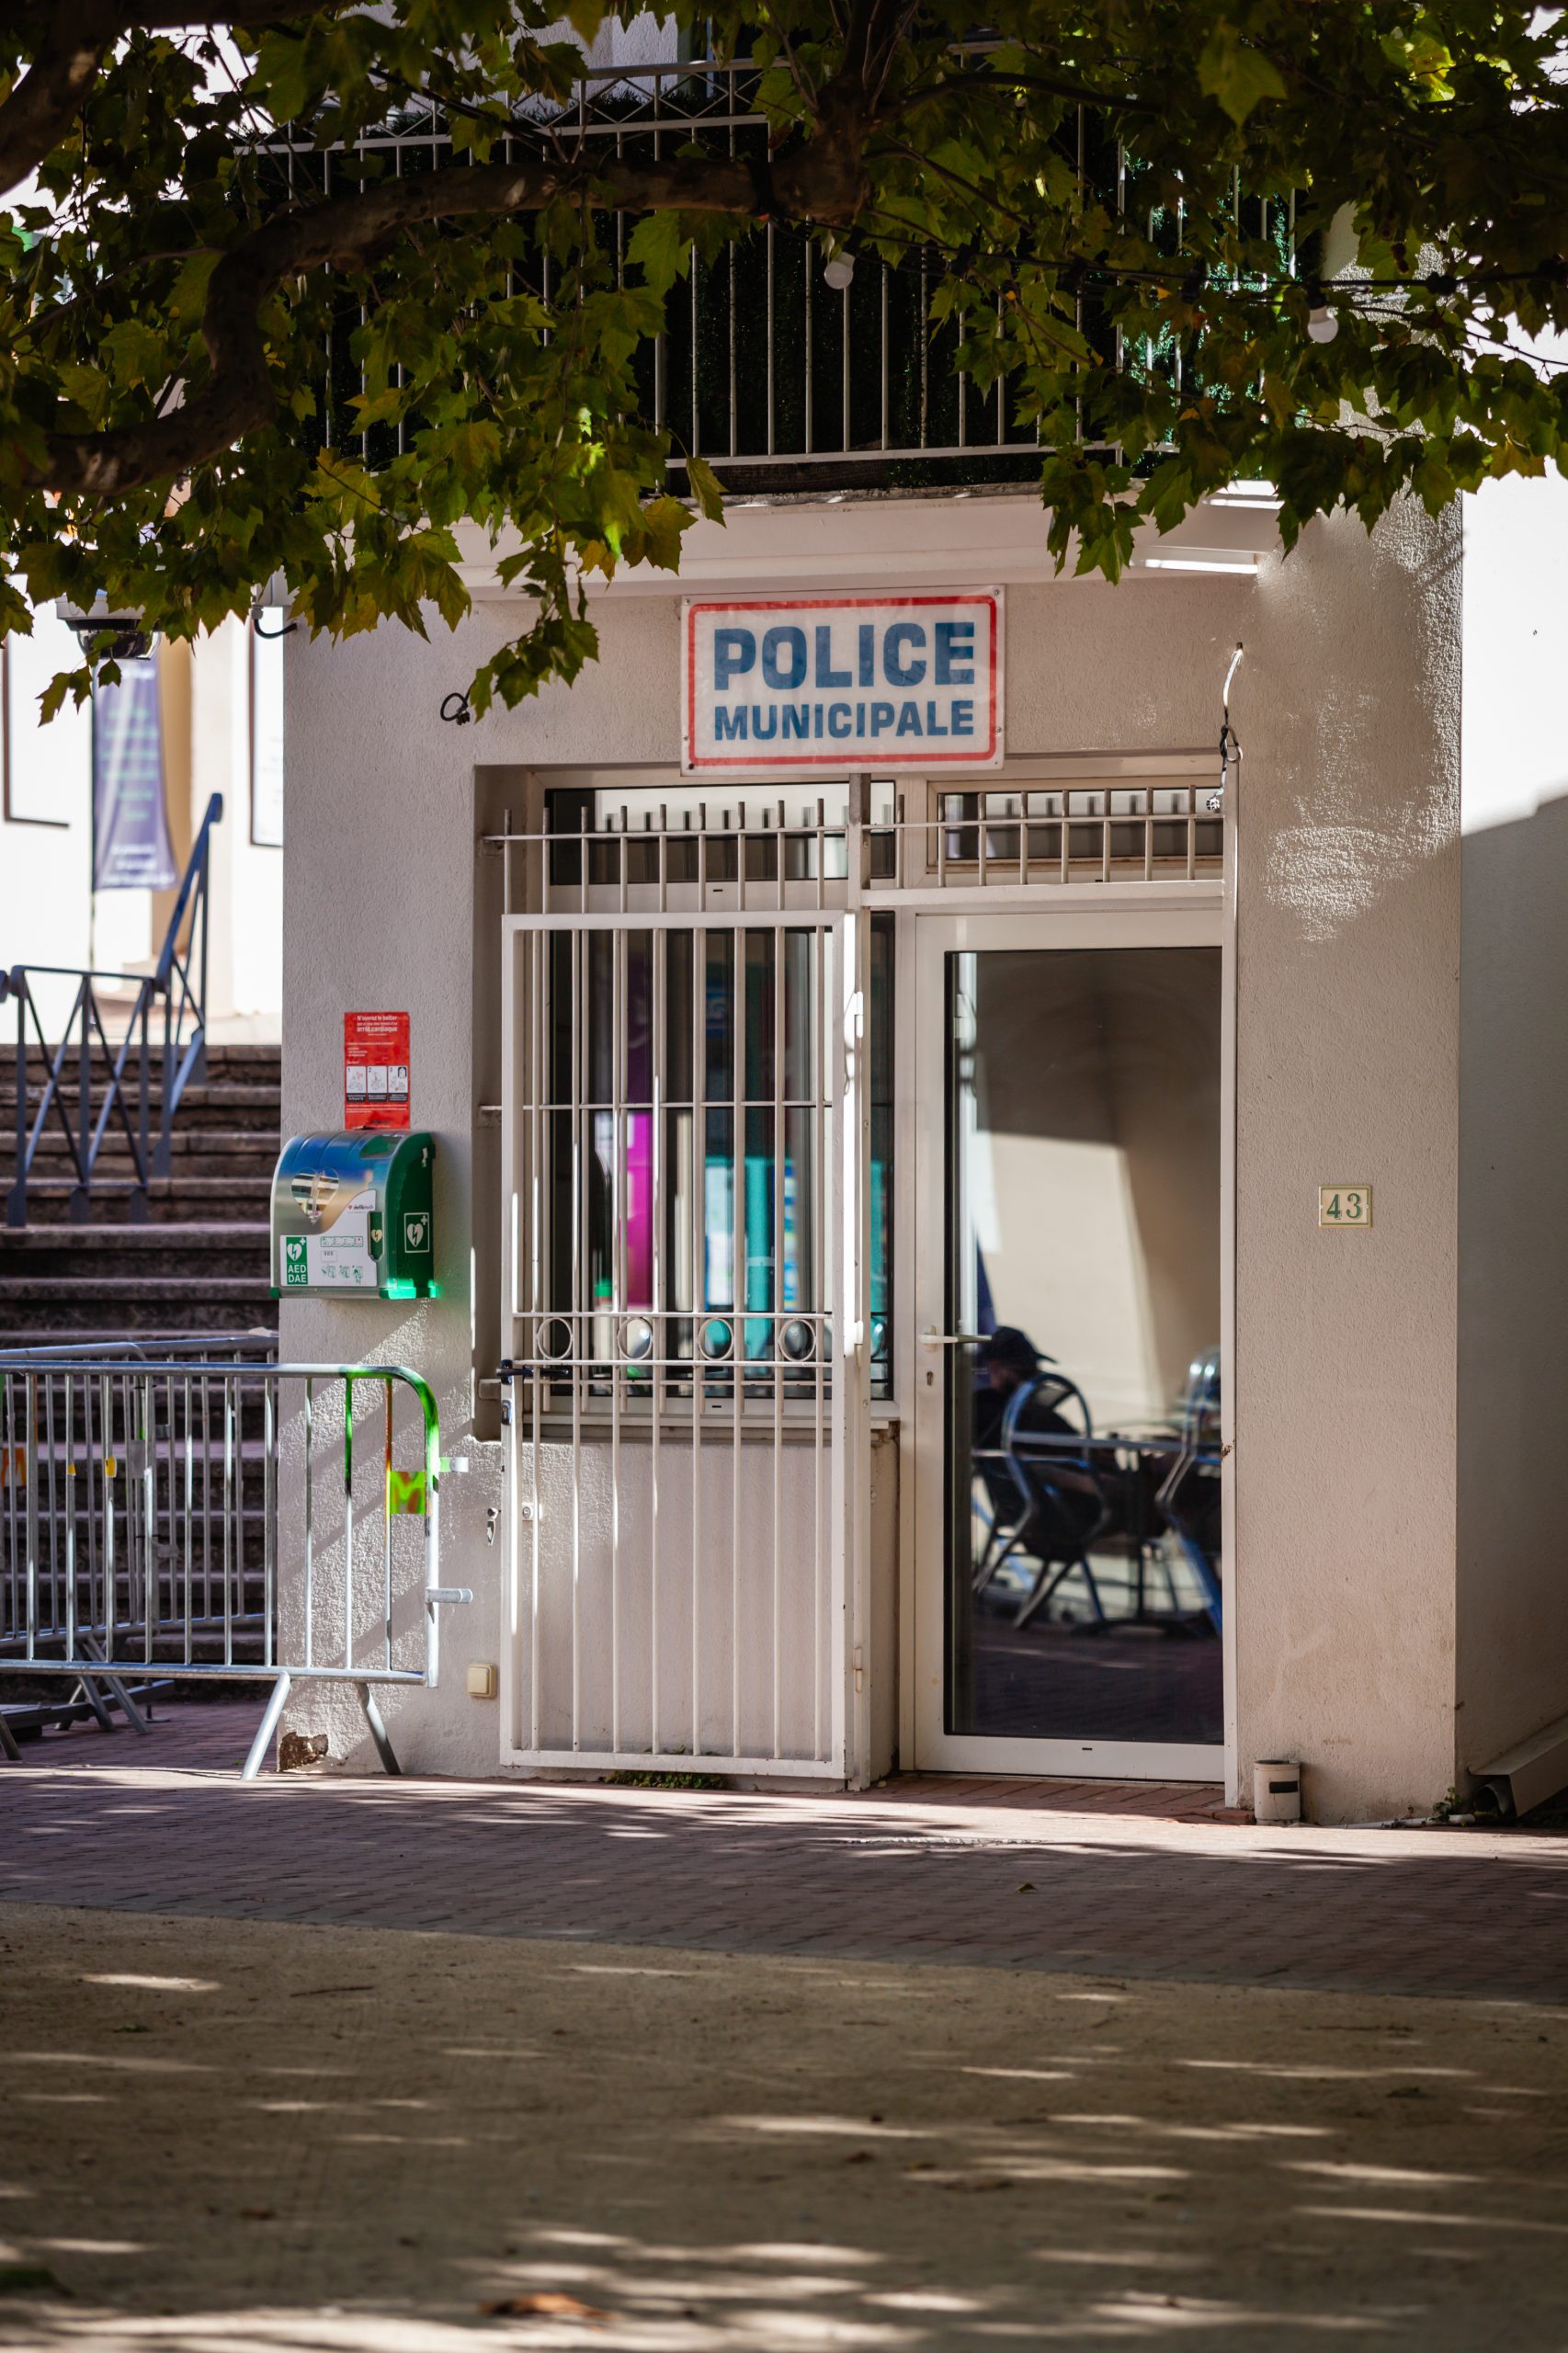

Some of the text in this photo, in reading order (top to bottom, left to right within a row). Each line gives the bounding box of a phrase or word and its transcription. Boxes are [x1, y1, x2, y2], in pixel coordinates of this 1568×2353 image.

[714, 621, 974, 690] POLICE
[714, 699, 974, 741] MUNICIPALE
[1326, 1193, 1362, 1219] 43
[288, 1264, 307, 1273] AED
[288, 1274, 307, 1283] DAE
